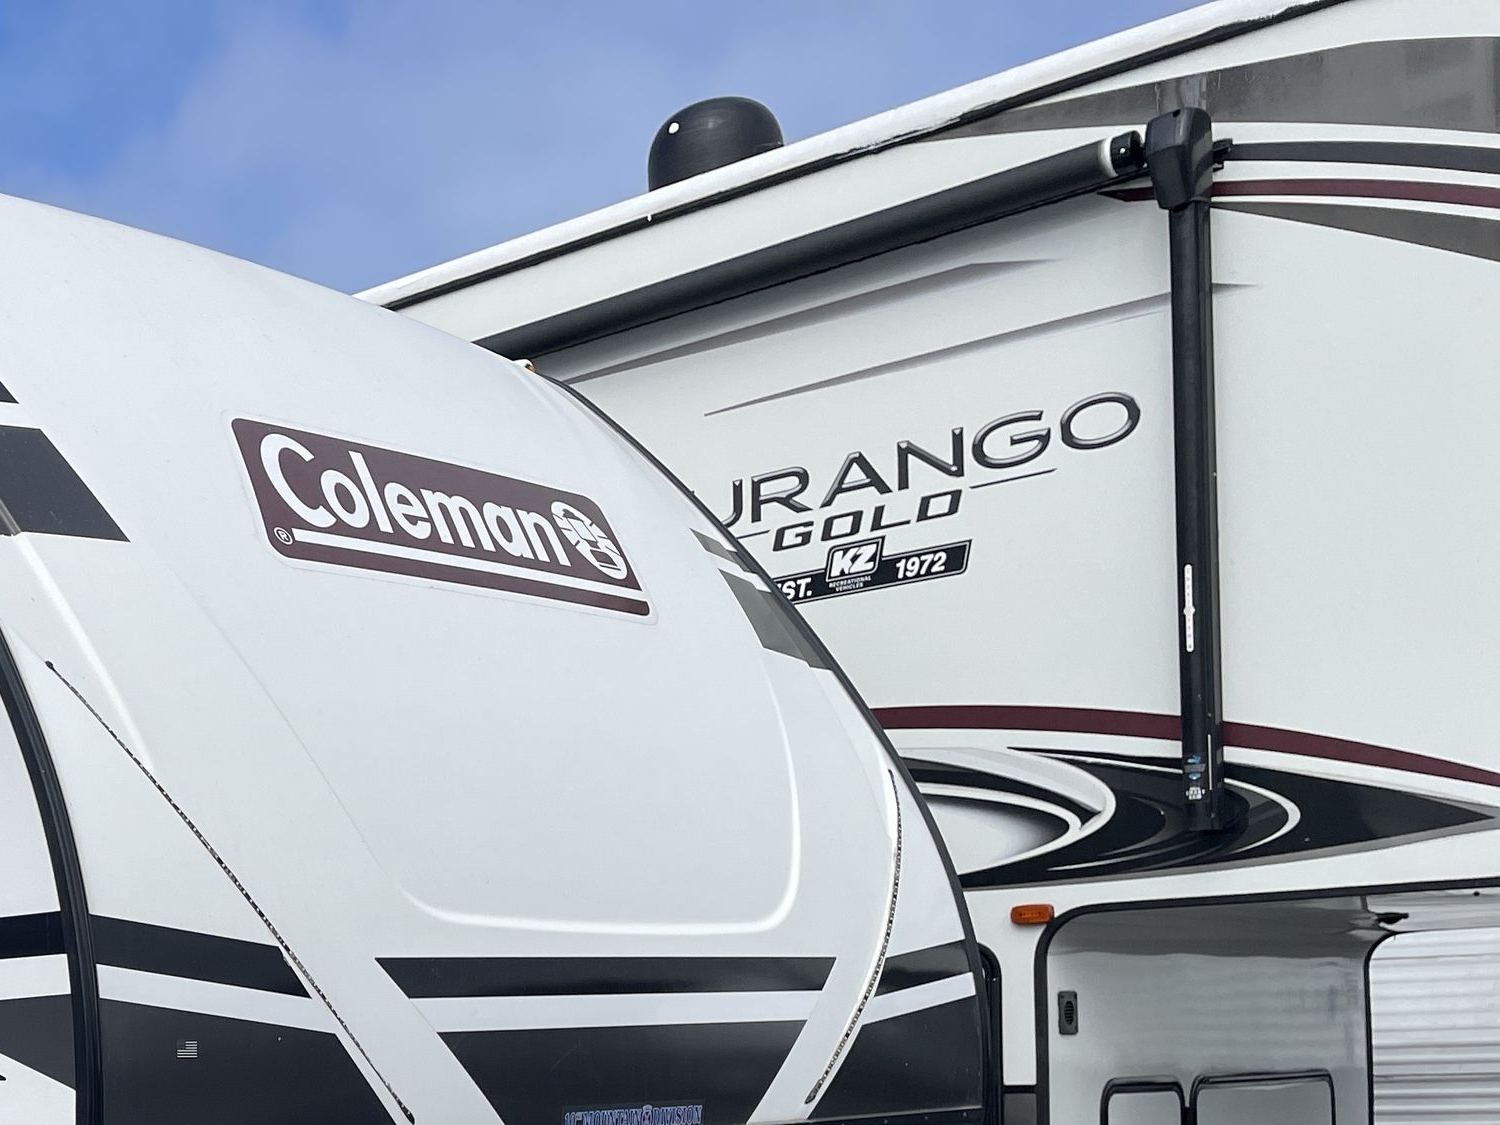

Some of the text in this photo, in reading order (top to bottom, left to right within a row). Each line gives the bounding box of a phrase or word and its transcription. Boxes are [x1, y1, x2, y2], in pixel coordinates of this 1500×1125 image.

[260, 432, 572, 567] Coleman
[772, 489, 963, 552] GOLD
[777, 551, 947, 600] ST. 1972
[829, 543, 878, 577] KZ
